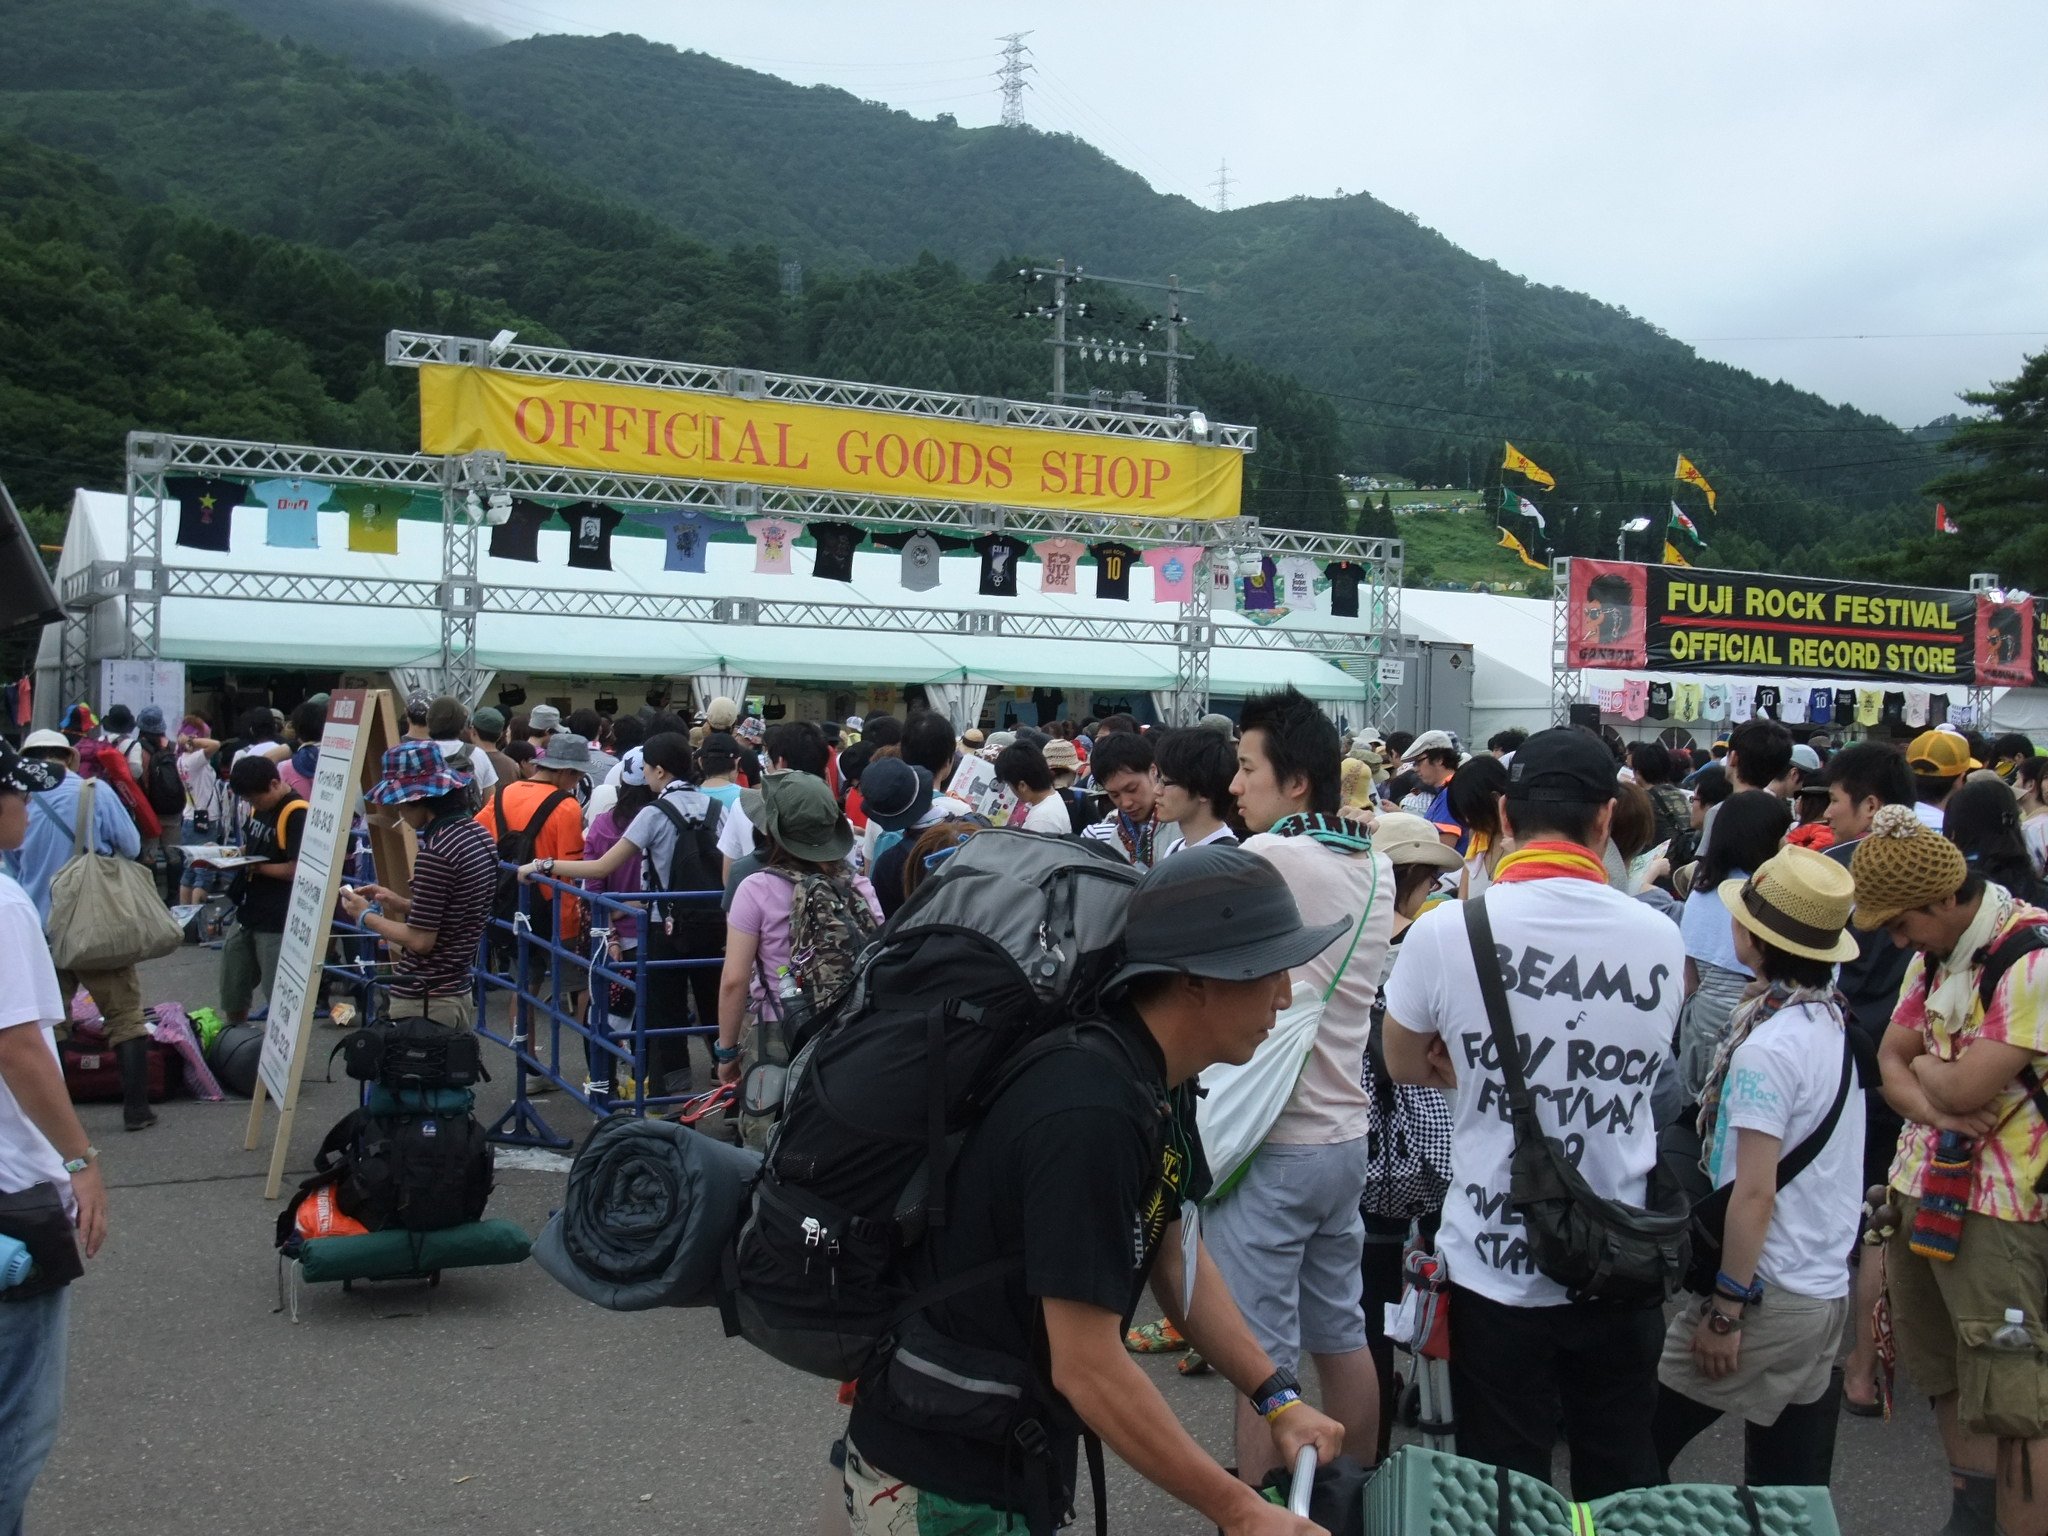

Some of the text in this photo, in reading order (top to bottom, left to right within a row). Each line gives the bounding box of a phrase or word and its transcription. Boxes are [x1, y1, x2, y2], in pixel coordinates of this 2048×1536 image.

[515, 396, 1172, 500] OFFICIAL GOODS SHOP
[1106, 556, 1122, 581] 10
[1667, 581, 1957, 630] FUJI ROCK FESTIVAL
[1670, 630, 1956, 674] OFFICIAL RECORD STORE
[1762, 693, 1774, 707] 10
[1815, 696, 1827, 709] 10
[1494, 943, 1670, 1012] BEAMS
[1567, 1039, 1662, 1086] ROCK
[1737, 1069, 1766, 1088] Pop
[1740, 1081, 1778, 1104] Rock
